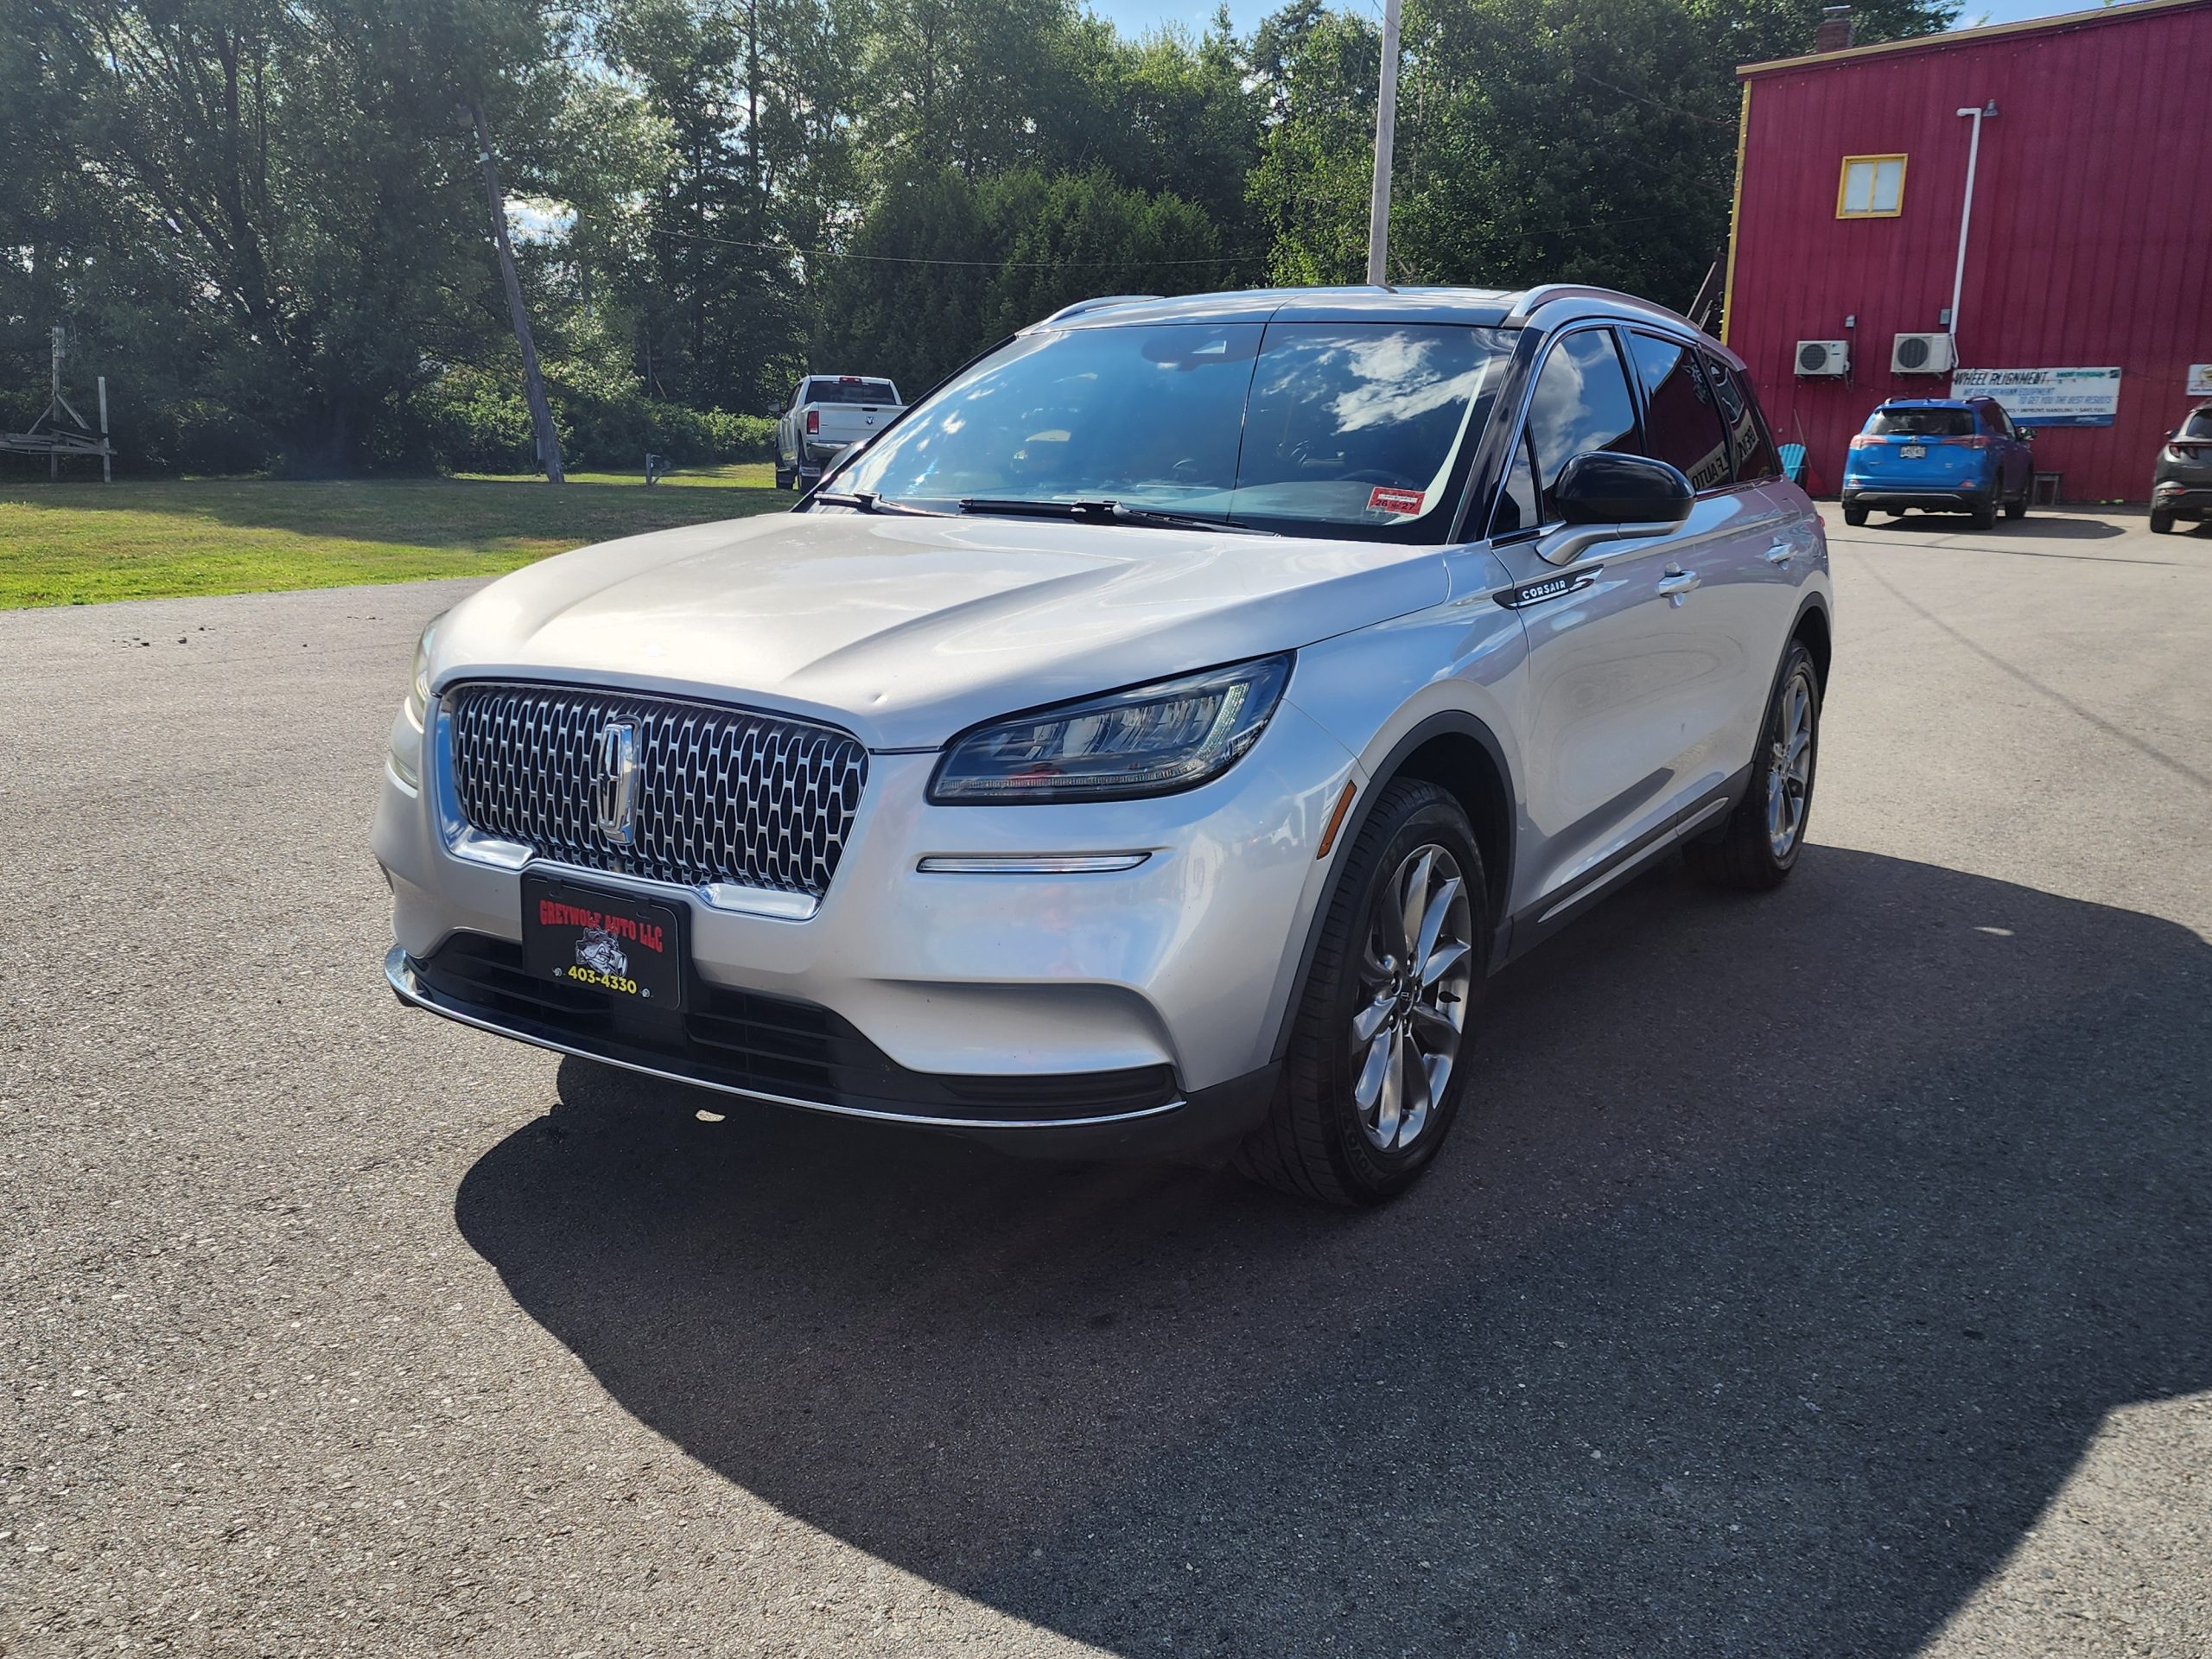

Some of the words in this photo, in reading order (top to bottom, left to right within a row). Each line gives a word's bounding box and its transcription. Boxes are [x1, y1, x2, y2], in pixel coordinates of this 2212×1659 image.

[1955, 372, 1986, 385] WHEEL
[1989, 371, 2049, 385] ALIGNMENT
[1522, 580, 1566, 600] CORSAIR
[539, 899, 602, 927] GREYWOLF
[605, 914, 637, 941] AUTO
[639, 922, 664, 952] LLC
[568, 965, 637, 995] 403-4330
